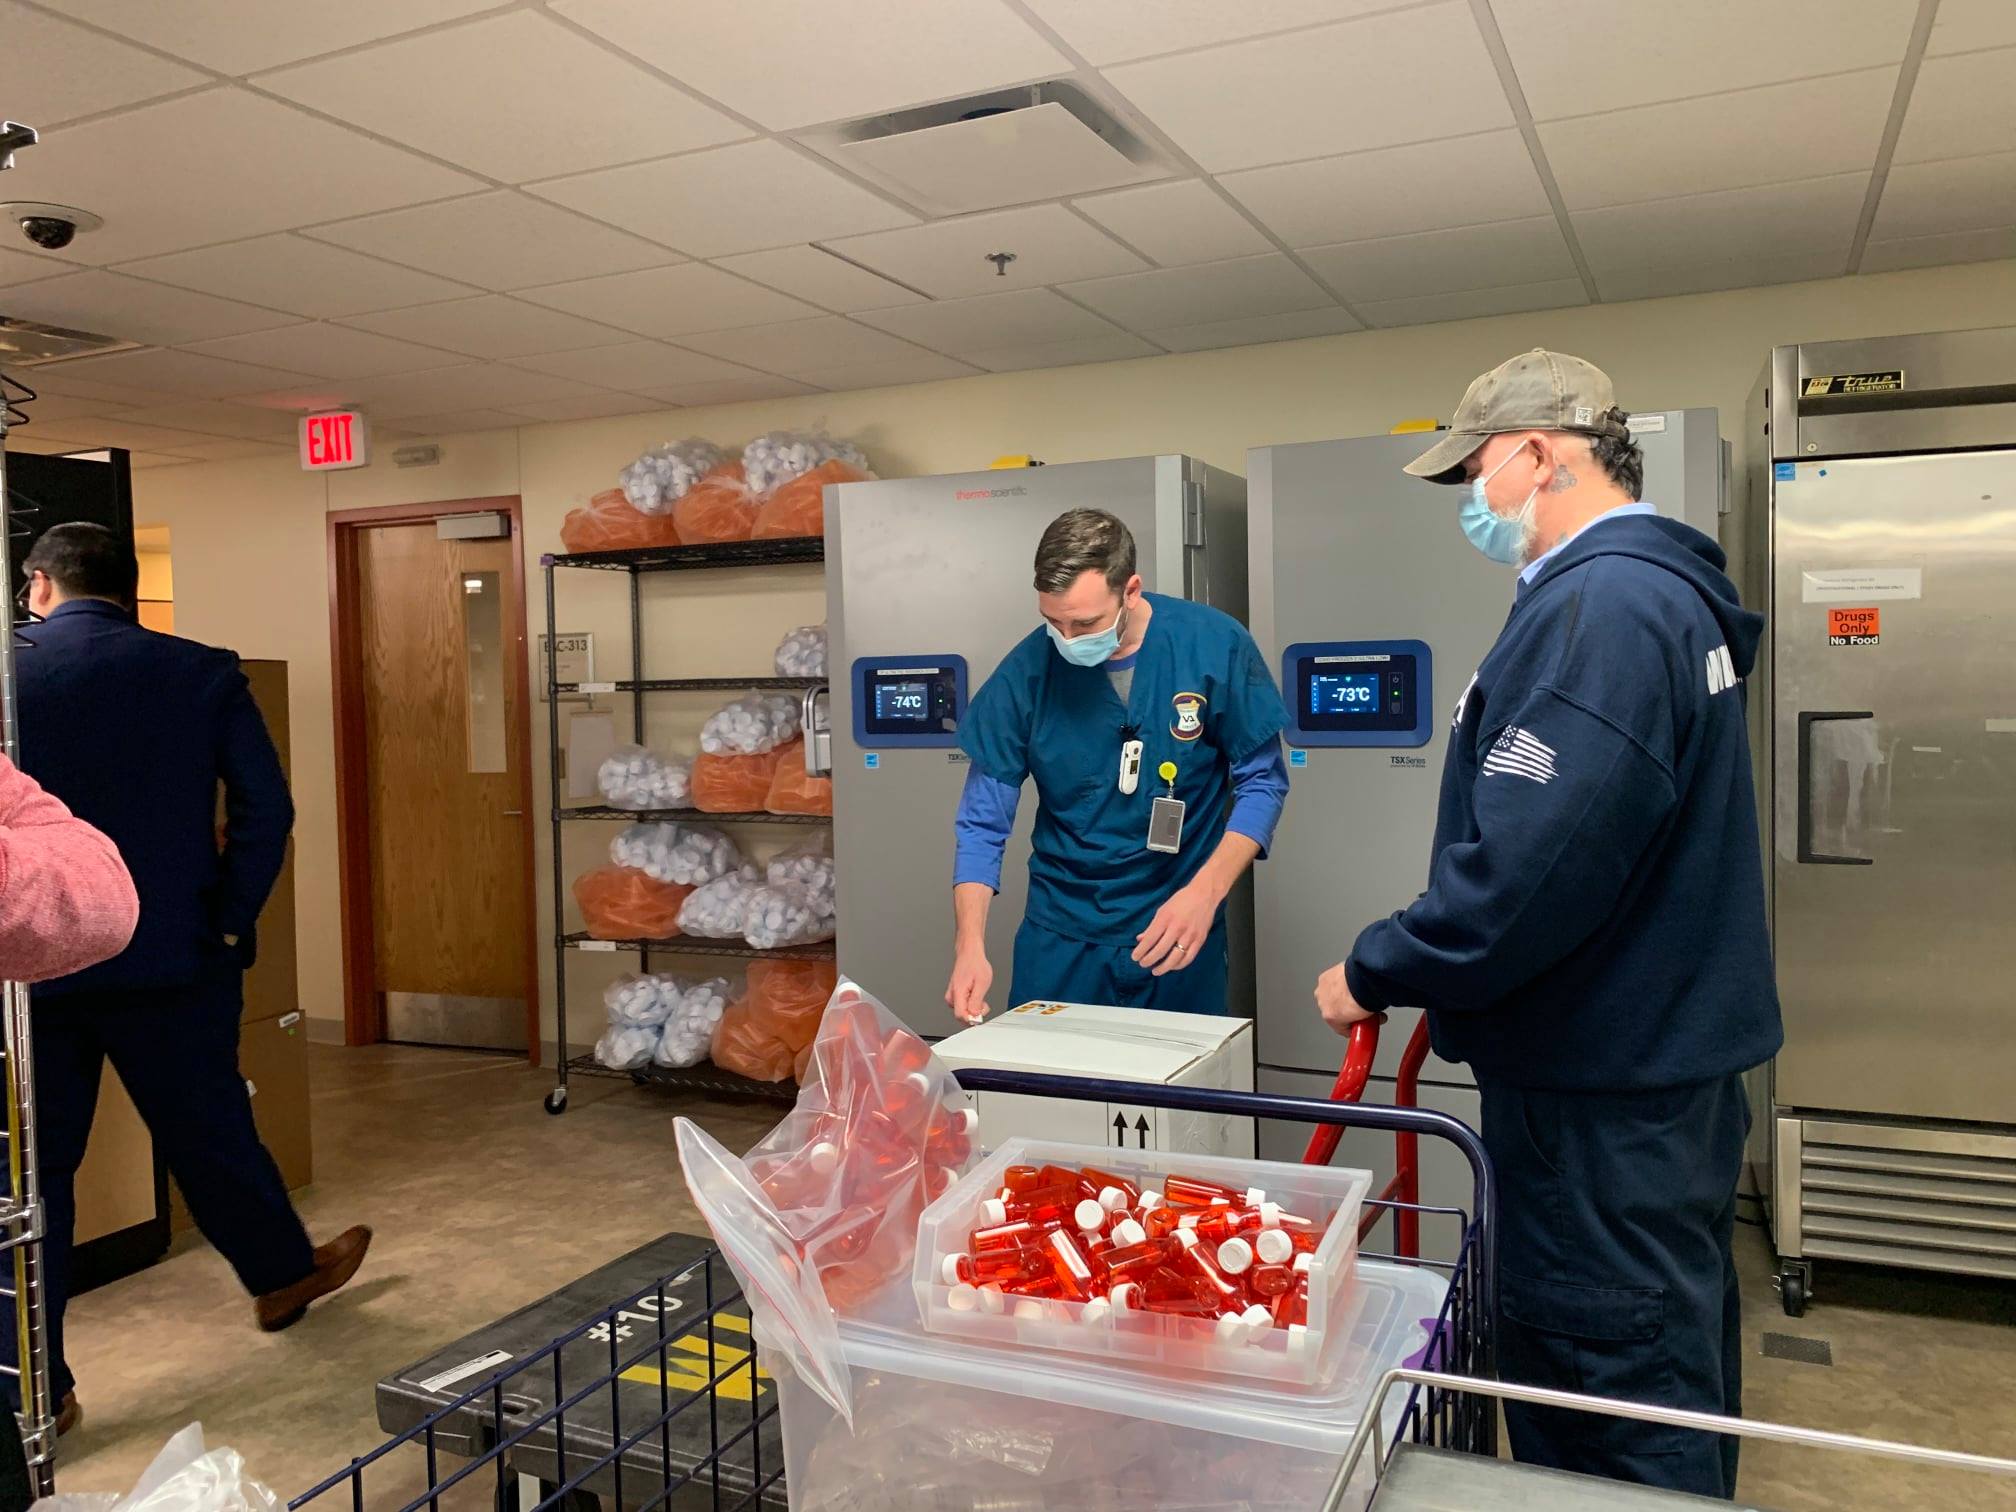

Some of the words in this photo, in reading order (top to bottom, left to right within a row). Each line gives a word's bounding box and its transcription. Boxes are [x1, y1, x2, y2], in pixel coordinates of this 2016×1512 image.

[307, 414, 353, 465] EXIT
[1834, 611, 1875, 623] Drugs
[1839, 623, 1870, 635] Only
[1830, 636, 1846, 645] No
[1850, 635, 1879, 645] Food
[588, 1295, 684, 1344] #10
